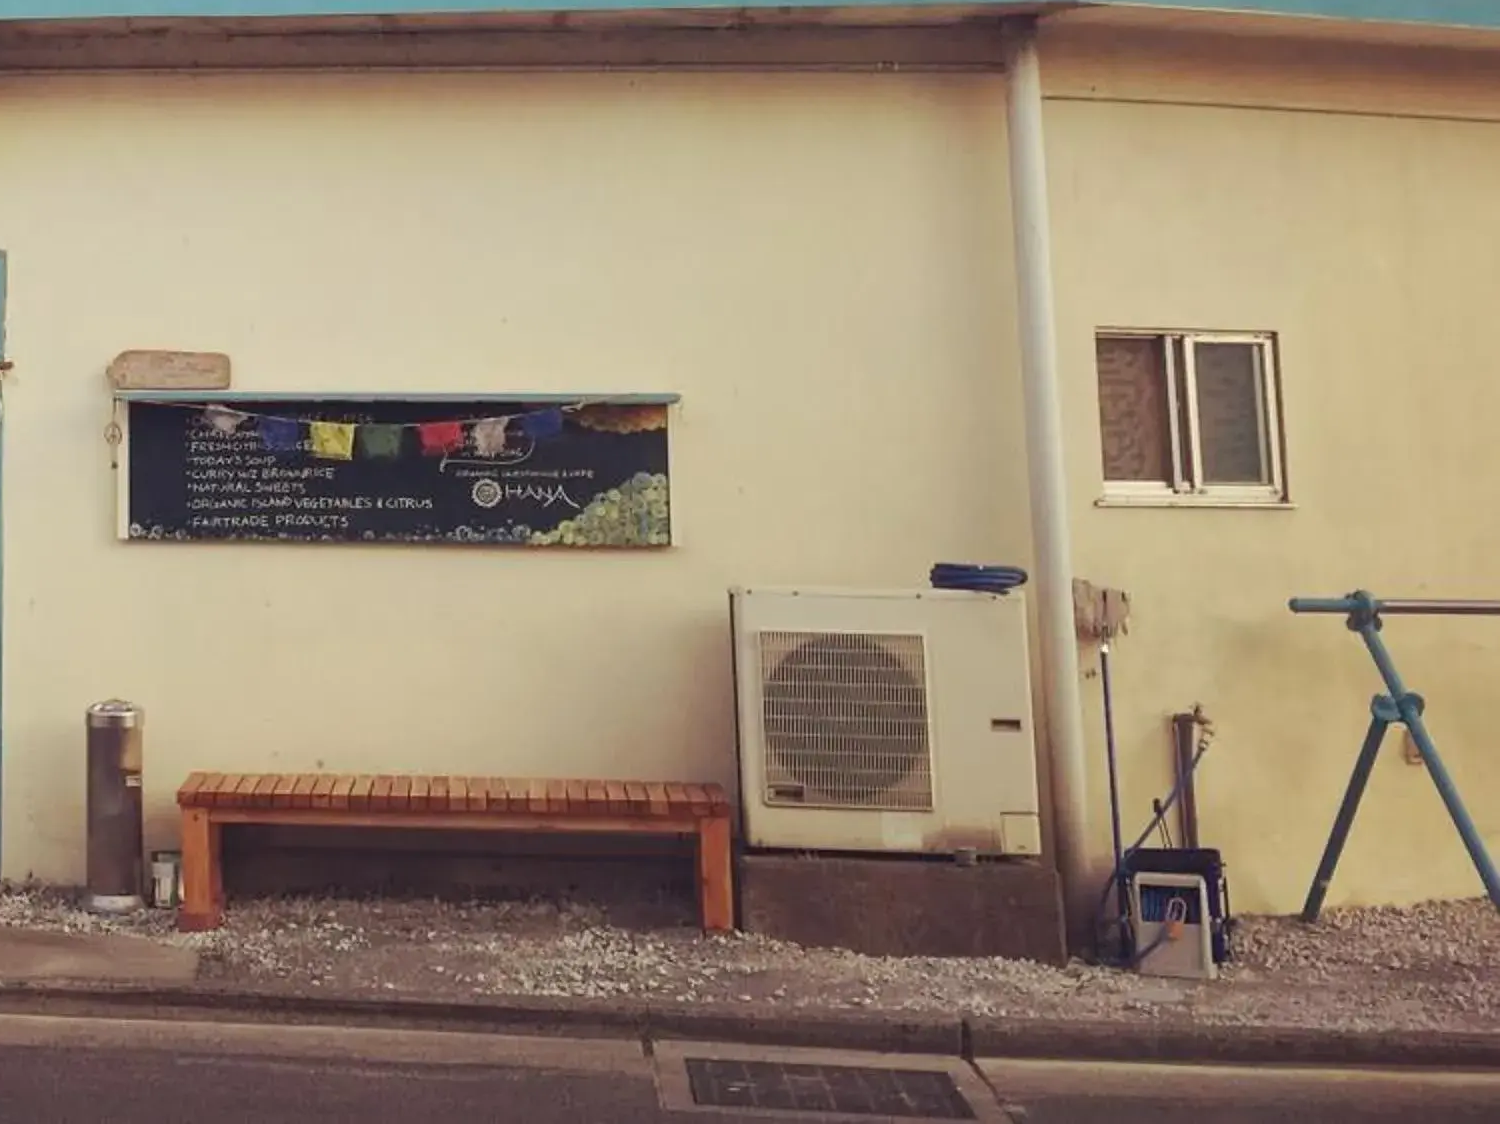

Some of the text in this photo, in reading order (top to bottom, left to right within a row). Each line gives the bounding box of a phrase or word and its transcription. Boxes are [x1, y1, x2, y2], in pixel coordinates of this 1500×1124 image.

[191, 497, 248, 510] ORGANIC
[293, 497, 373, 509] VEGETABLES
[385, 497, 433, 510] CITRUS
[192, 514, 350, 529] FAIRTRADE PRODUCTS
